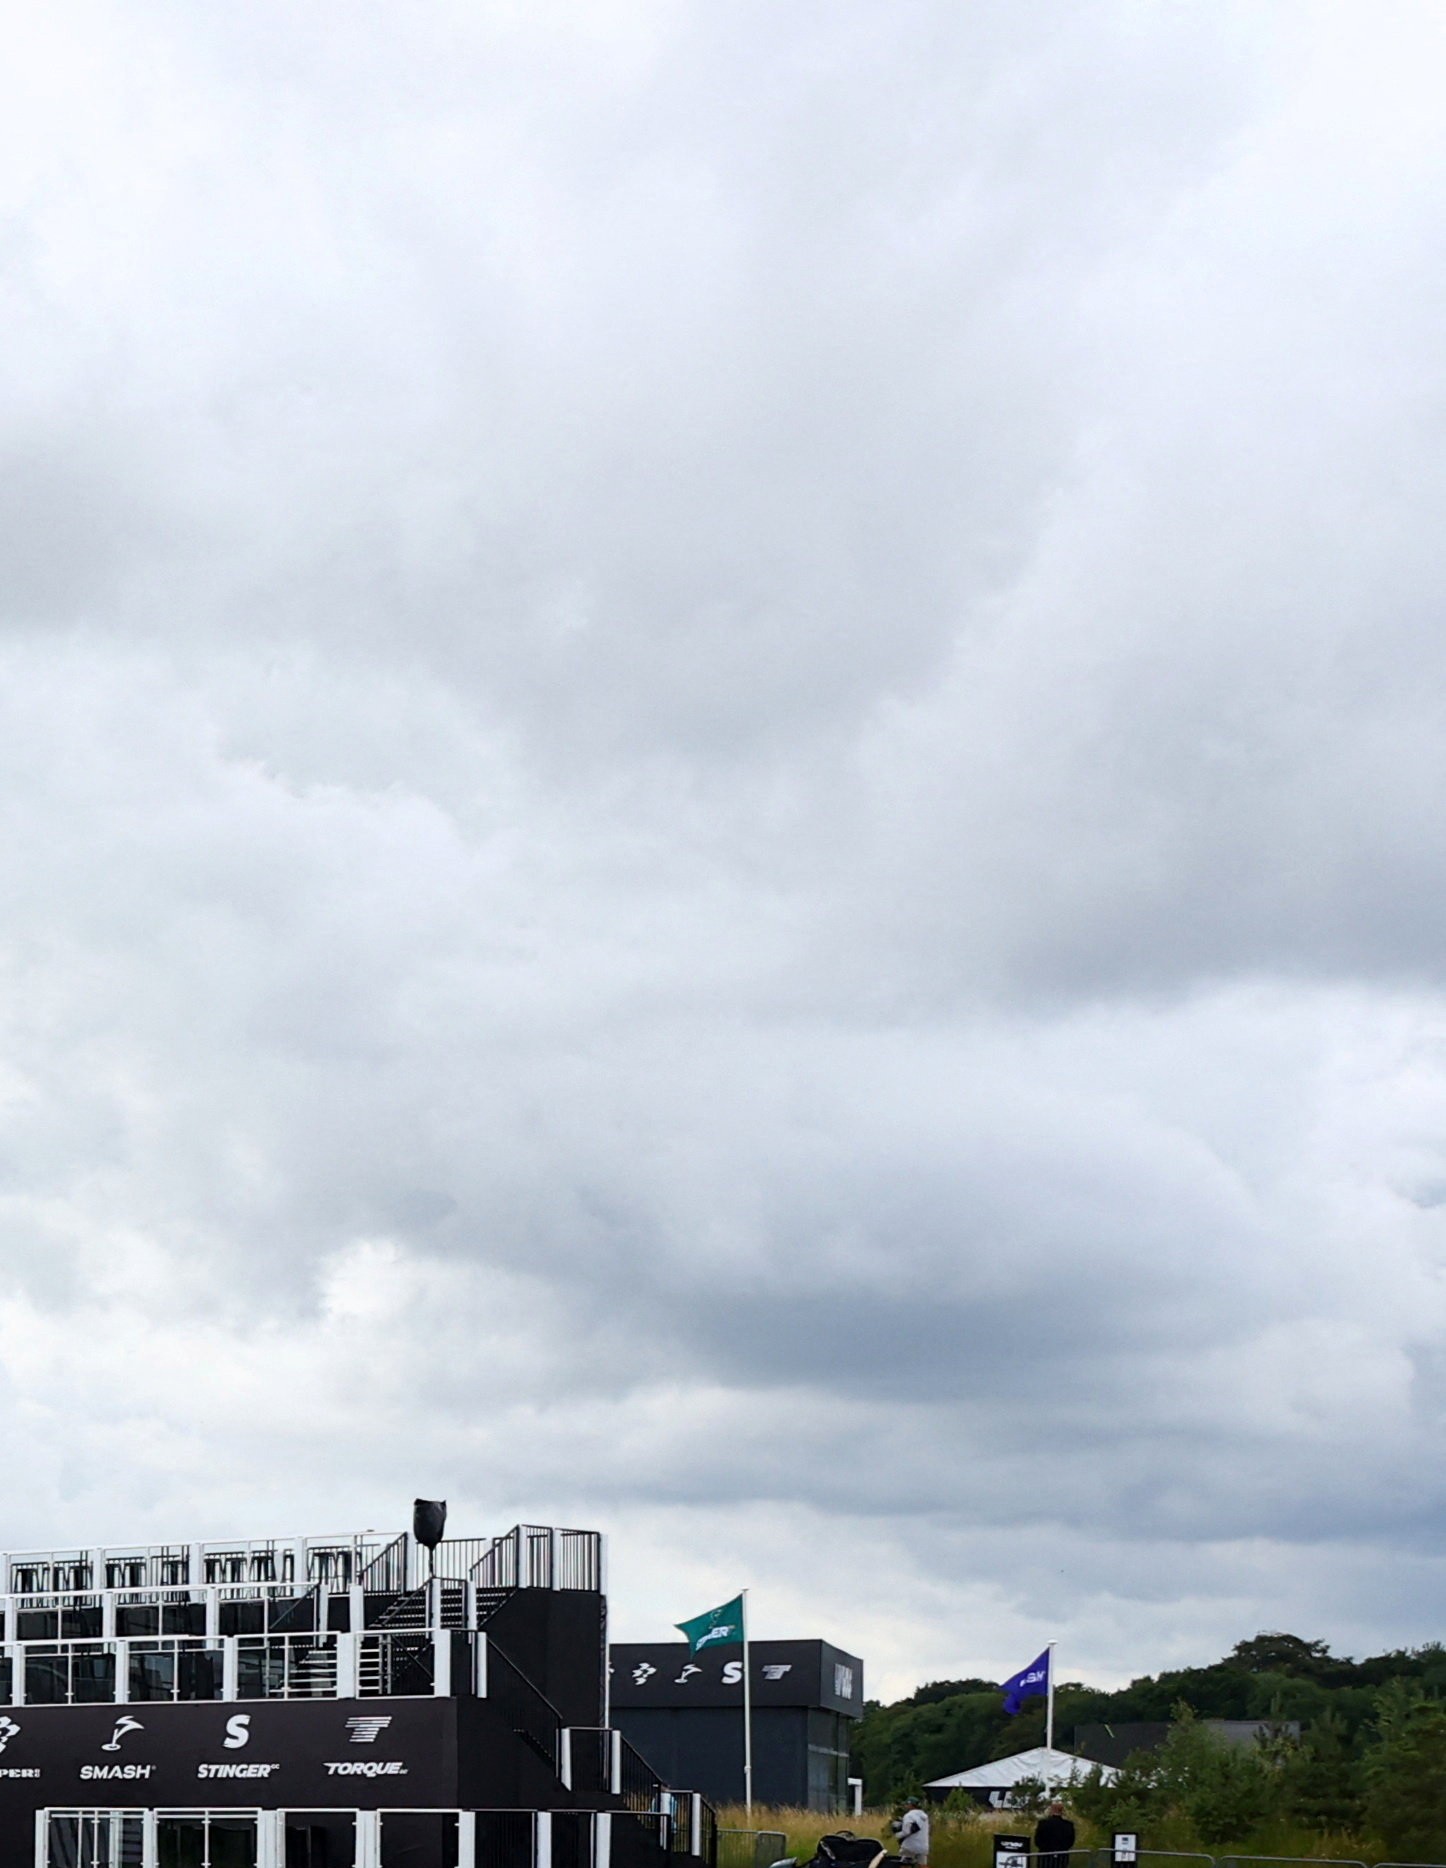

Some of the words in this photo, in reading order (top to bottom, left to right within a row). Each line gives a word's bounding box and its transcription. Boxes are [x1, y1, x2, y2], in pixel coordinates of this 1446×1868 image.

[79, 1764, 152, 1780] SMASH
[197, 1763, 272, 1778] STINGER
[323, 1762, 403, 1778] TORQUE
